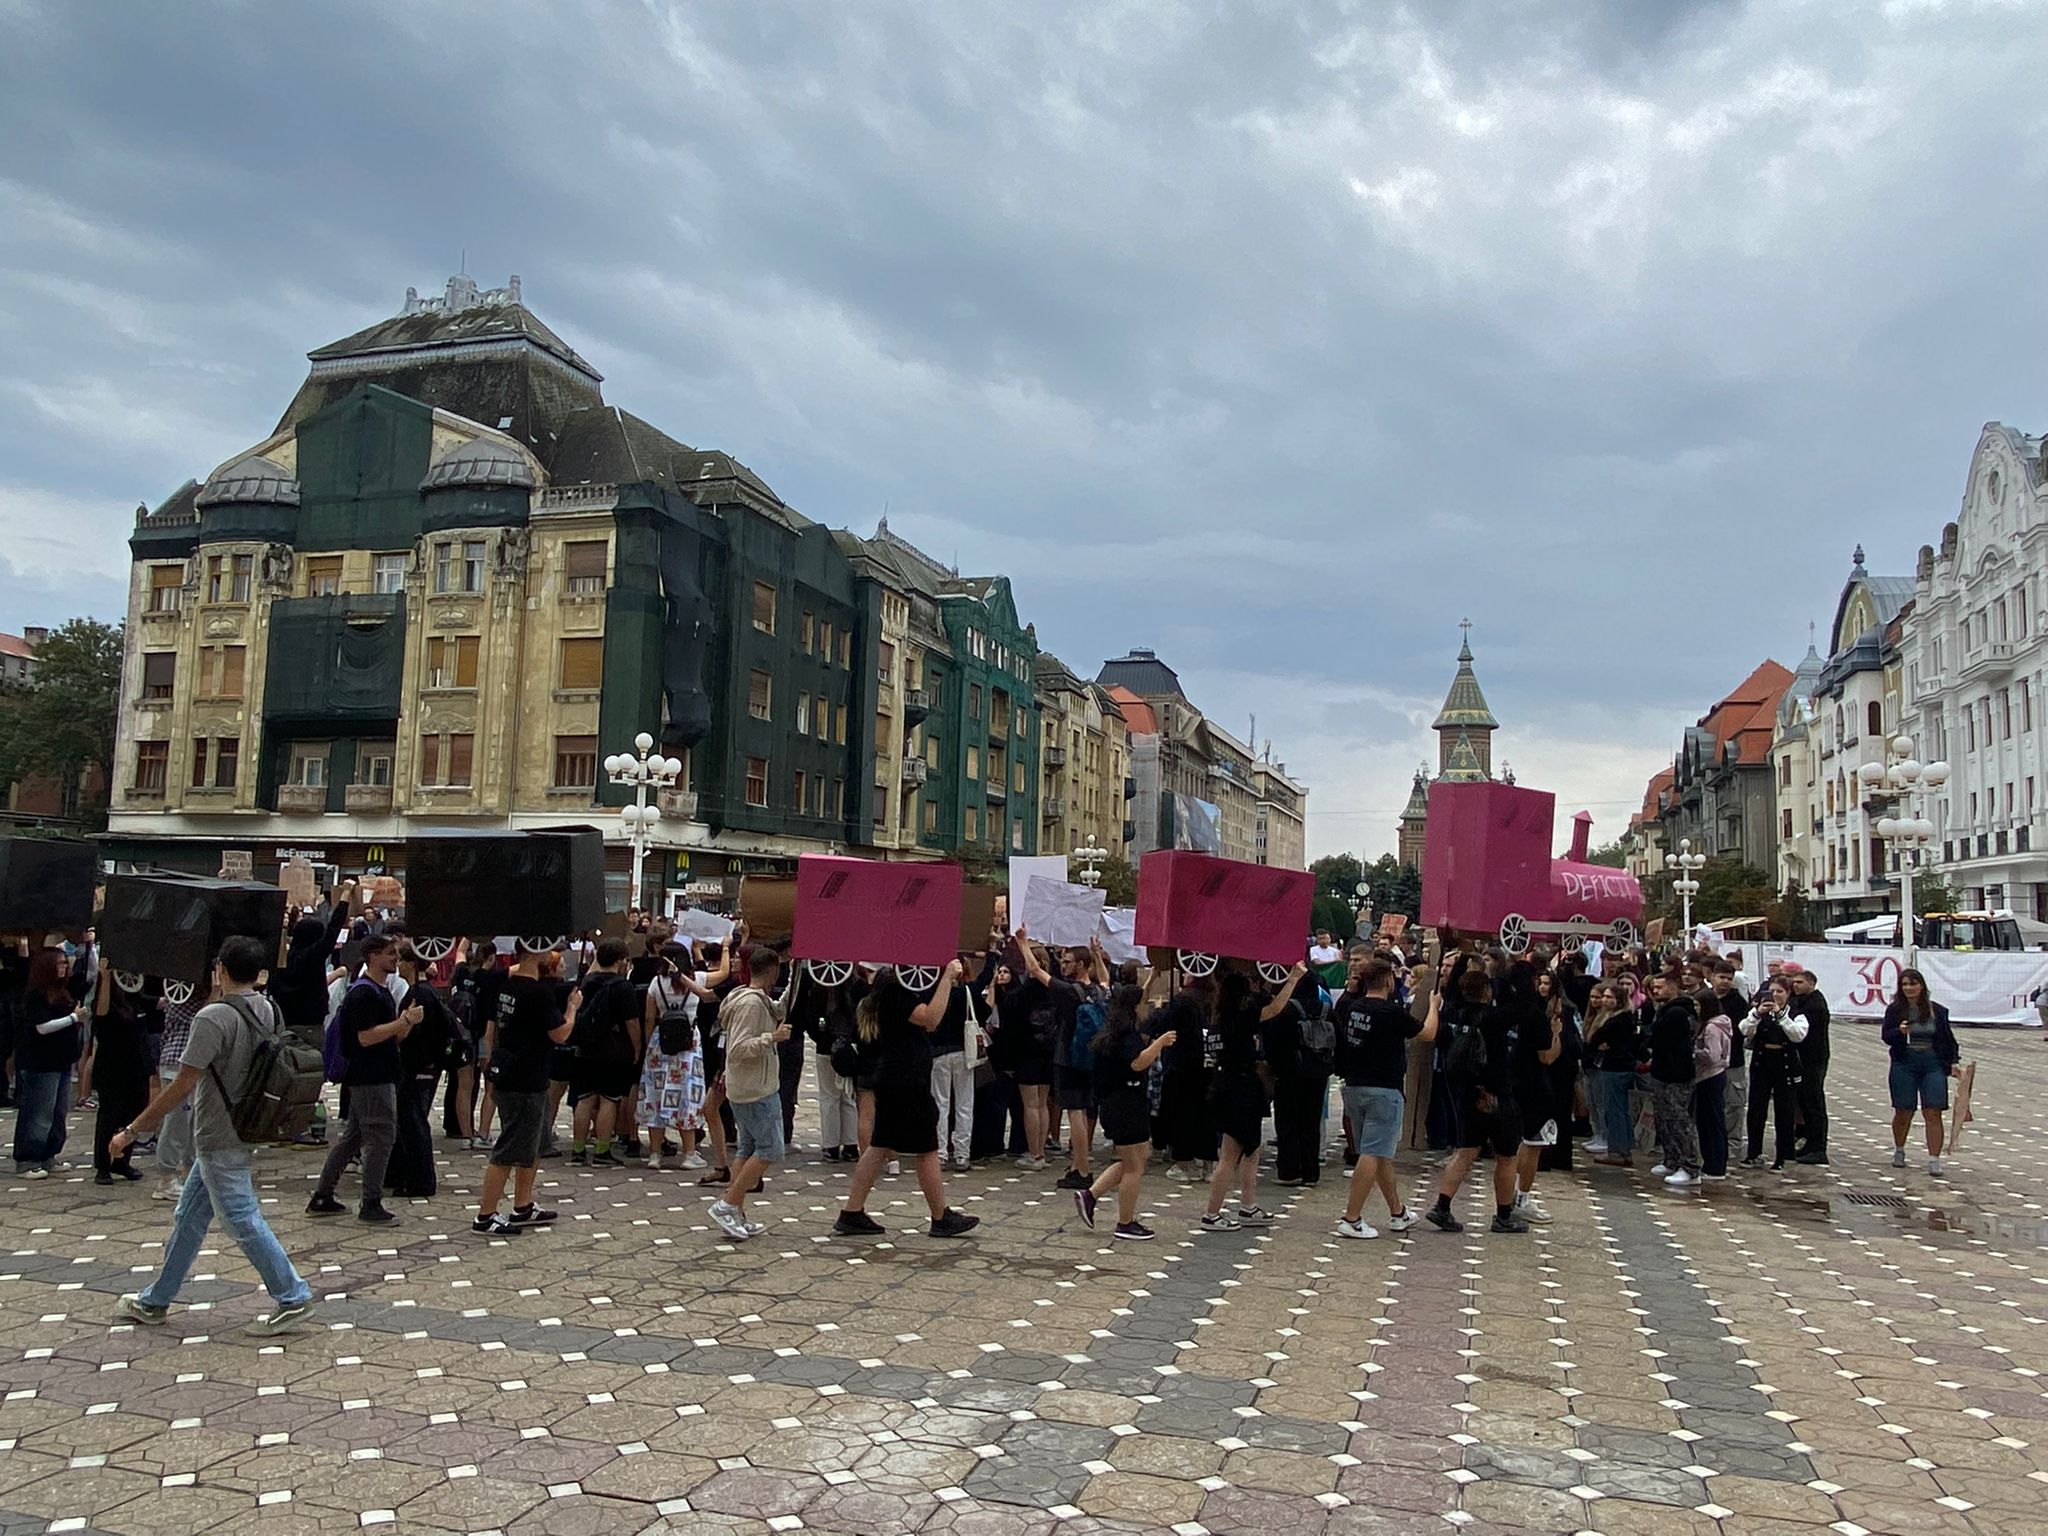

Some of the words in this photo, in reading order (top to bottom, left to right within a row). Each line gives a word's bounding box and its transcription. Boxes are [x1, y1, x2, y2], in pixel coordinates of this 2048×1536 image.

[276, 848, 325, 859] McExpress
[1561, 872, 1632, 901] DEFICIT
[1849, 956, 1903, 1006] 30
